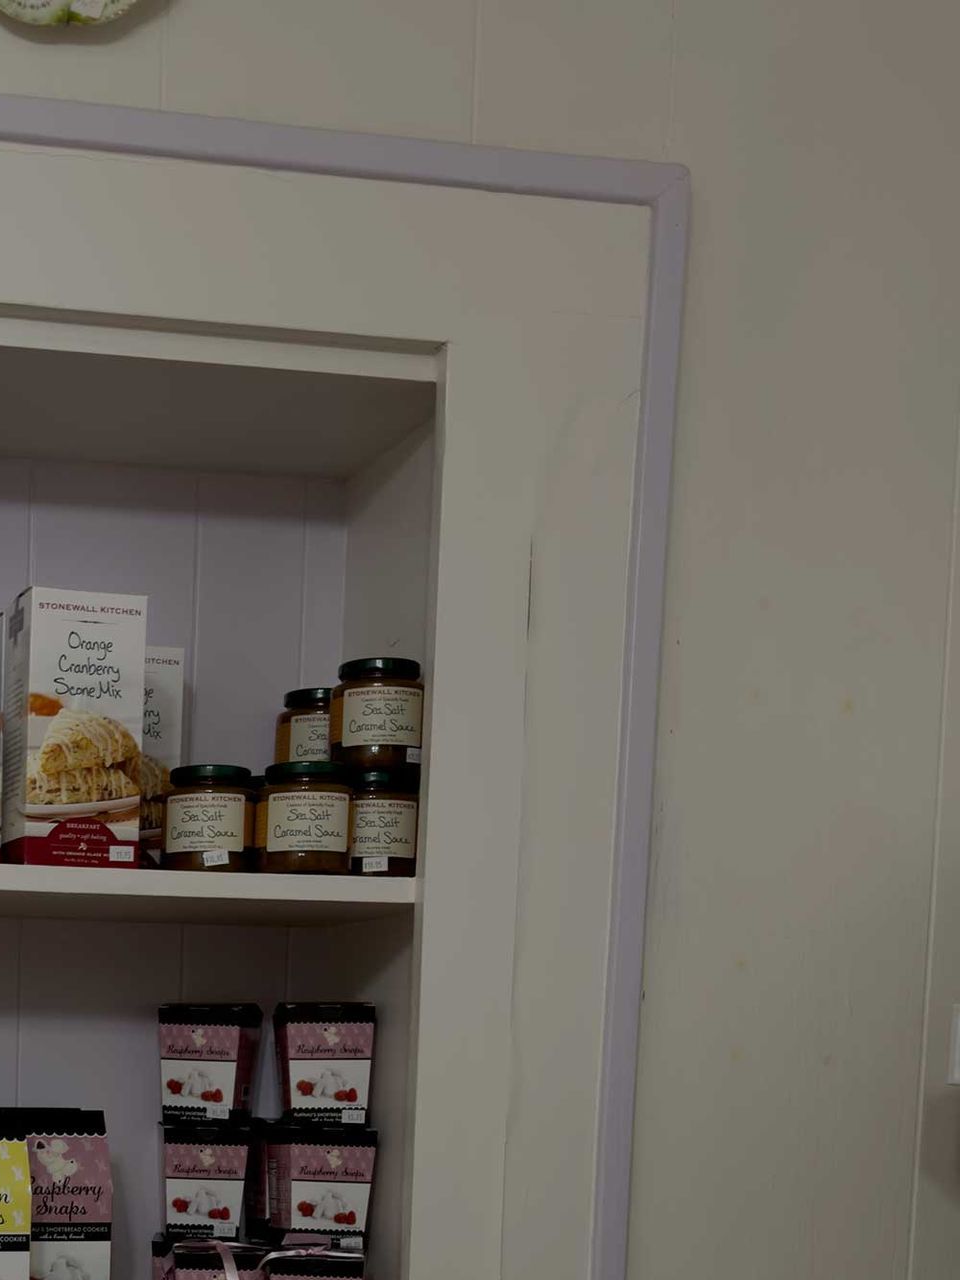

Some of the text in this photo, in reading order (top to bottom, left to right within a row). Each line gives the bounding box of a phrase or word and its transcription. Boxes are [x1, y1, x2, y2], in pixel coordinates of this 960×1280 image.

[39, 602, 142, 617] STONEWALL KITCHEN
[68, 631, 113, 661] Orange
[58, 654, 121, 683] Cranberry
[53, 677, 122, 699] Scone Mix
[362, 703, 407, 716] Sea Salt
[349, 719, 387, 733] Caramel
[296, 745, 328, 756] Carame
[181, 809, 225, 823] Sea Salt
[309, 808, 333, 821] Salt
[378, 816, 401, 828] Salt
[171, 826, 204, 840] Caramel
[273, 824, 312, 839] Caramel
[352, 832, 381, 844] ramel
[36, 1197, 87, 1221] Snaps
